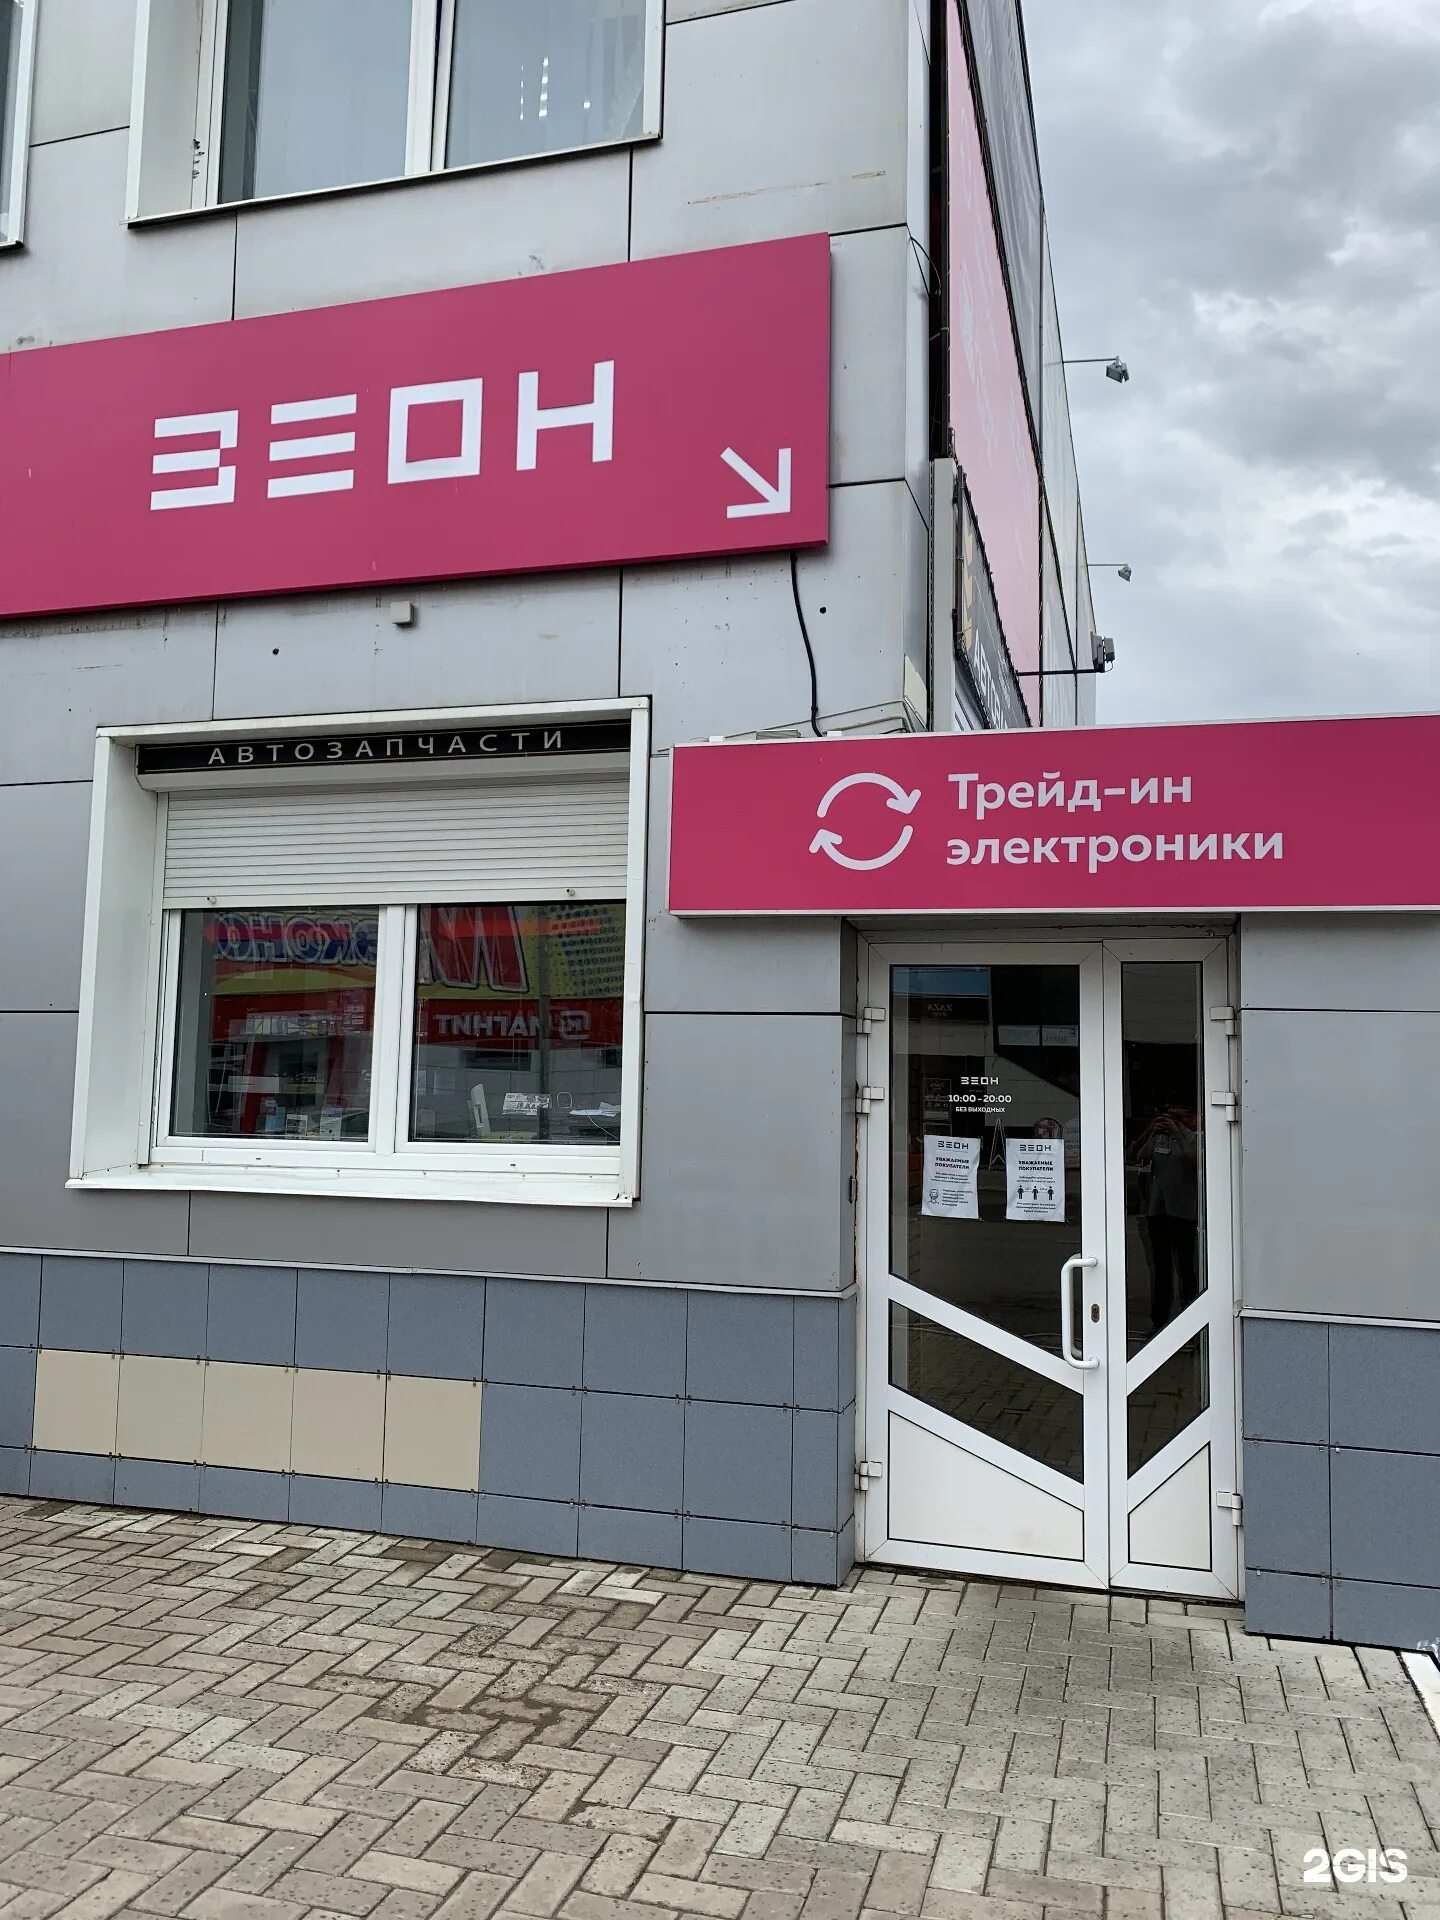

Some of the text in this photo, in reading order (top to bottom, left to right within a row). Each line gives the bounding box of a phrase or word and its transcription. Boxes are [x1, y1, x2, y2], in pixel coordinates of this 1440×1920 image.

[150, 359, 615, 512] ЗЕОН
[207, 730, 563, 766] АВТОЗАПЧАСТИ
[947, 769, 1193, 820] Трейд-ин
[945, 830, 1285, 875] электроники
[960, 1076, 999, 1085] ЗЕОН
[937, 1140, 969, 1150] ЗЕОН
[1019, 1144, 1052, 1152] ЗЕОН
[935, 1156, 970, 1164] УВАЖАЕМЫЕ
[934, 1162, 970, 1170] ПОКУПАТЕЛИ
